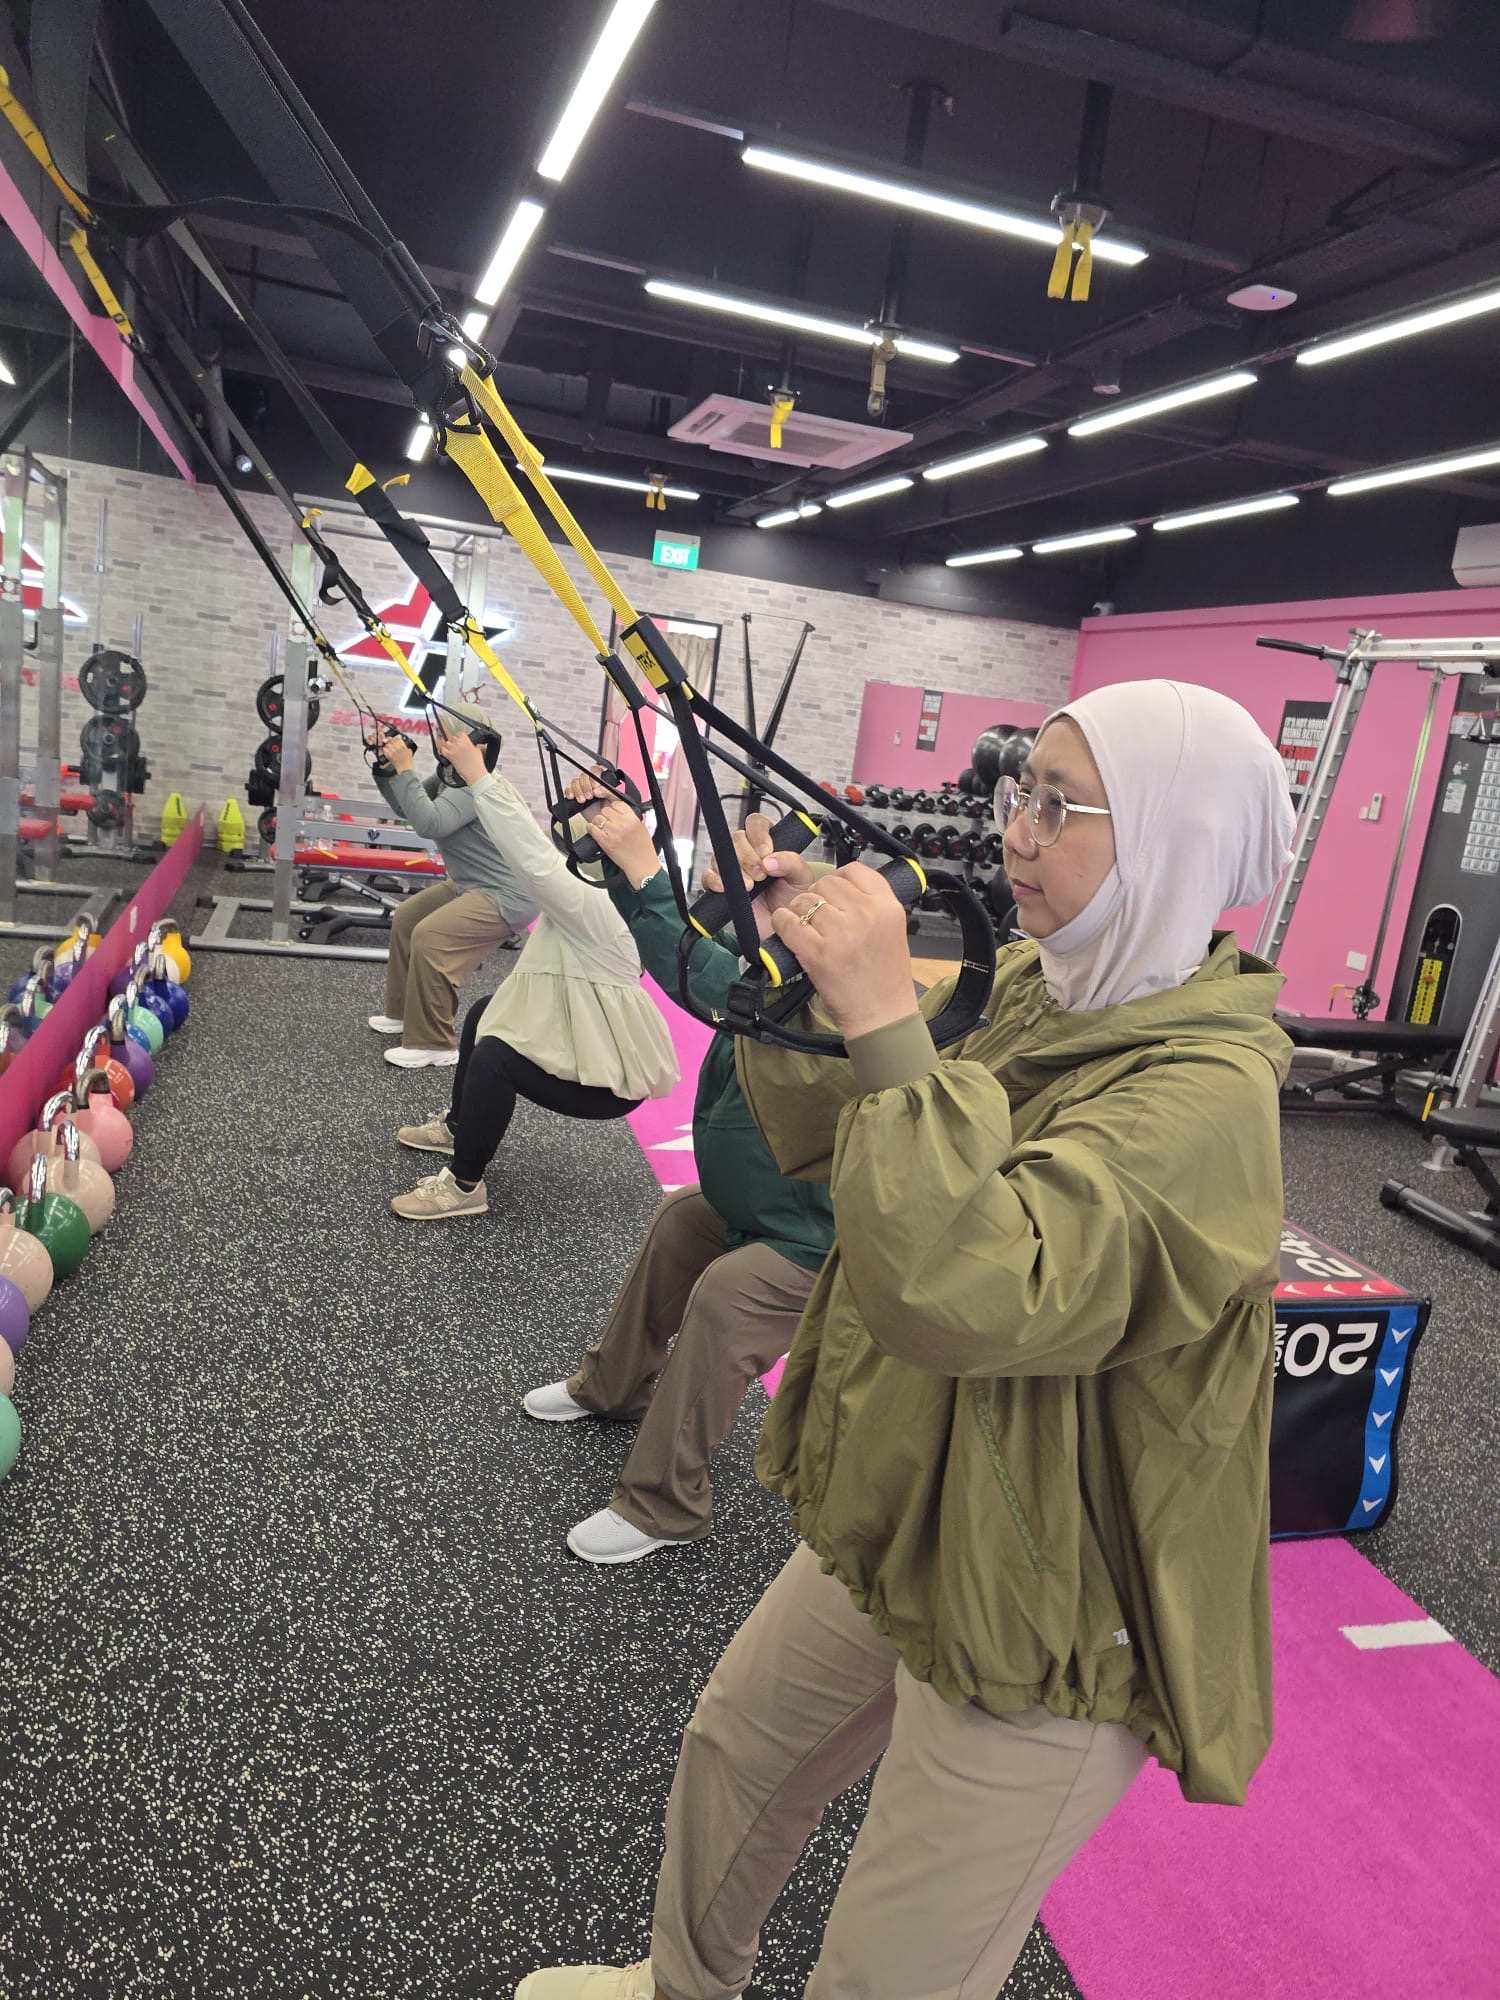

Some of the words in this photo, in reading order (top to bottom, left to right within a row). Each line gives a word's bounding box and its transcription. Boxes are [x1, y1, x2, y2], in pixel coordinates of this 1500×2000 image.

[661, 545, 690, 566] EXIT
[636, 651, 656, 671] TRX
[1284, 1322, 1378, 1377] 20
